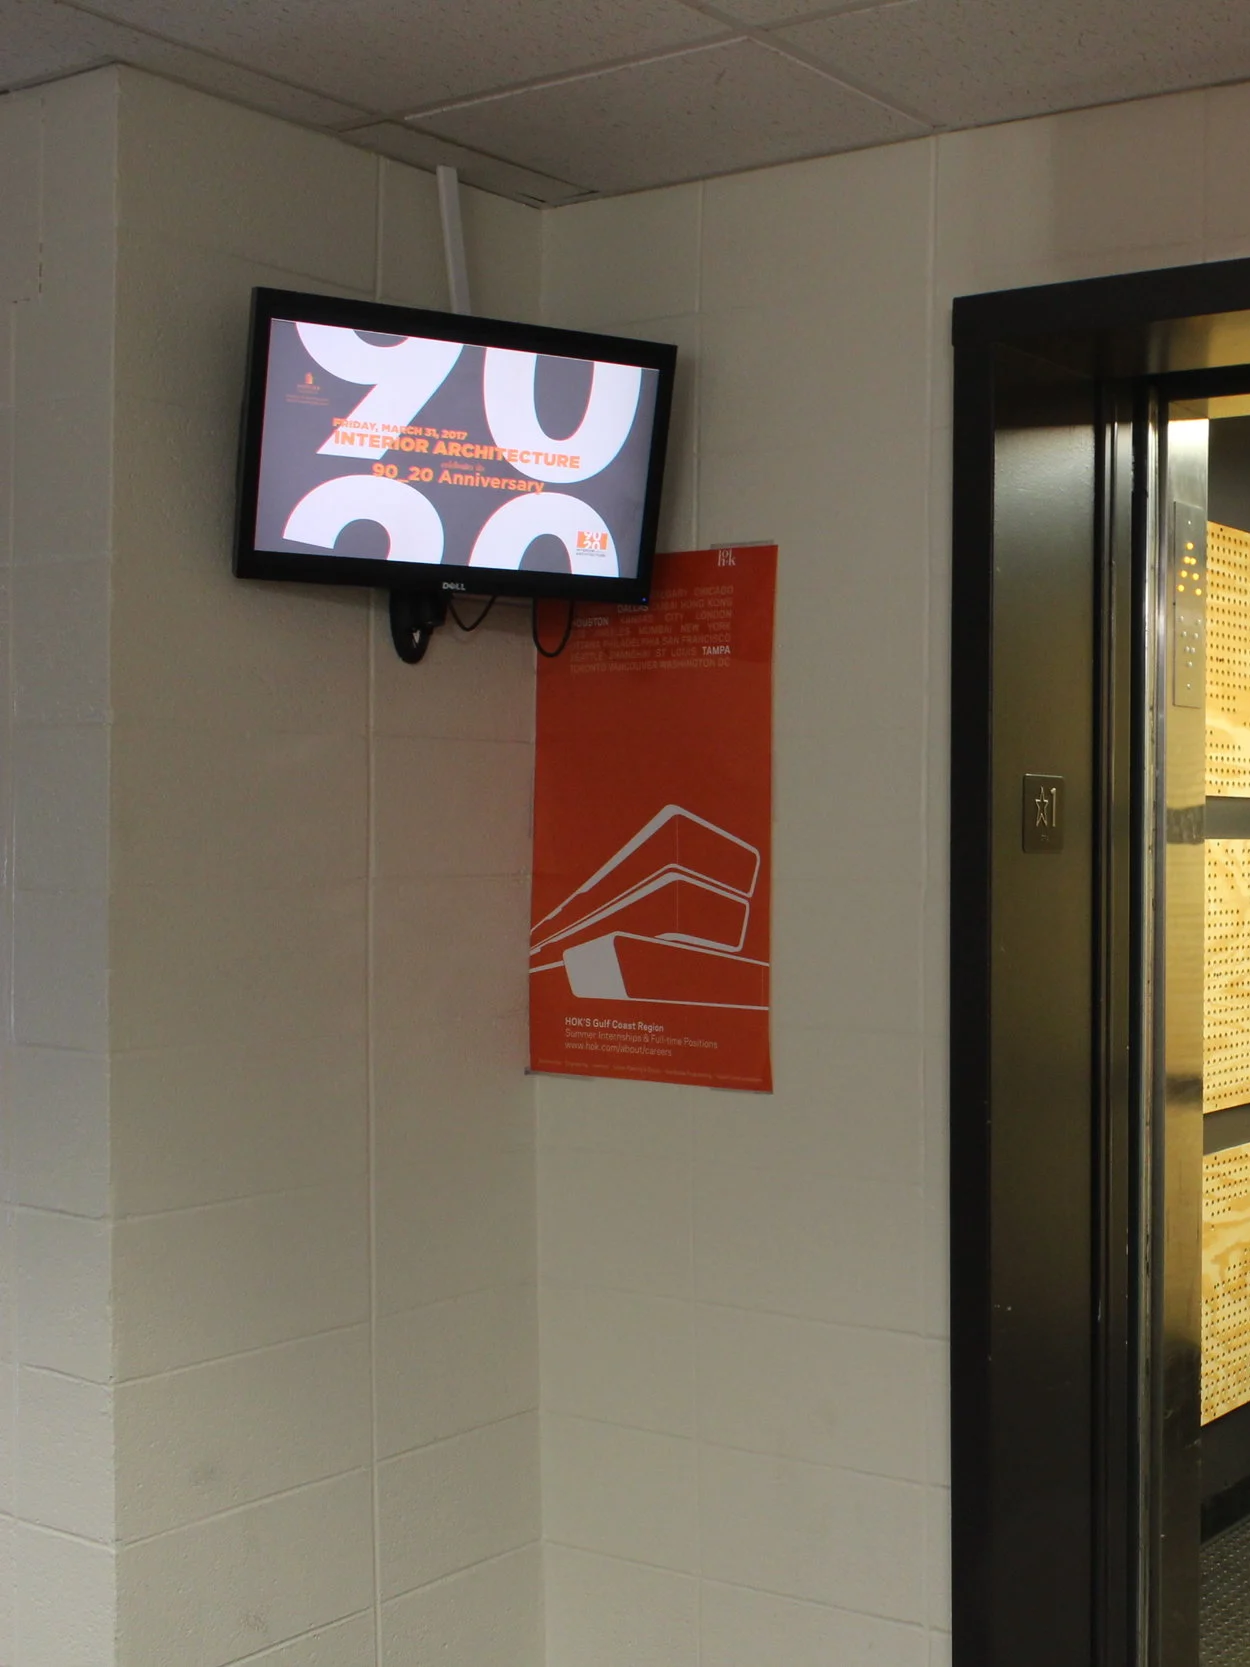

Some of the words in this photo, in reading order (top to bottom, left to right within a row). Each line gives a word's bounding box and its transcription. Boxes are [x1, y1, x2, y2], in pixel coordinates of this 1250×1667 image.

[332, 417, 379, 432] FRIDAY,
[382, 423, 423, 436] MARCH
[440, 429, 468, 440] 2017
[334, 430, 429, 453] INTERIOR
[433, 439, 581, 469] ARCHITECTURE
[372, 462, 434, 483] 90_20
[437, 469, 545, 494] Anniversary
[442, 581, 466, 591] DELL
[701, 644, 731, 656] TAMPA
[1050, 787, 1057, 828] 1
[564, 1016, 591, 1027] HOK'S
[592, 1017, 612, 1028] Gulf
[611, 1019, 636, 1030] Coast
[637, 1021, 664, 1034] Region
